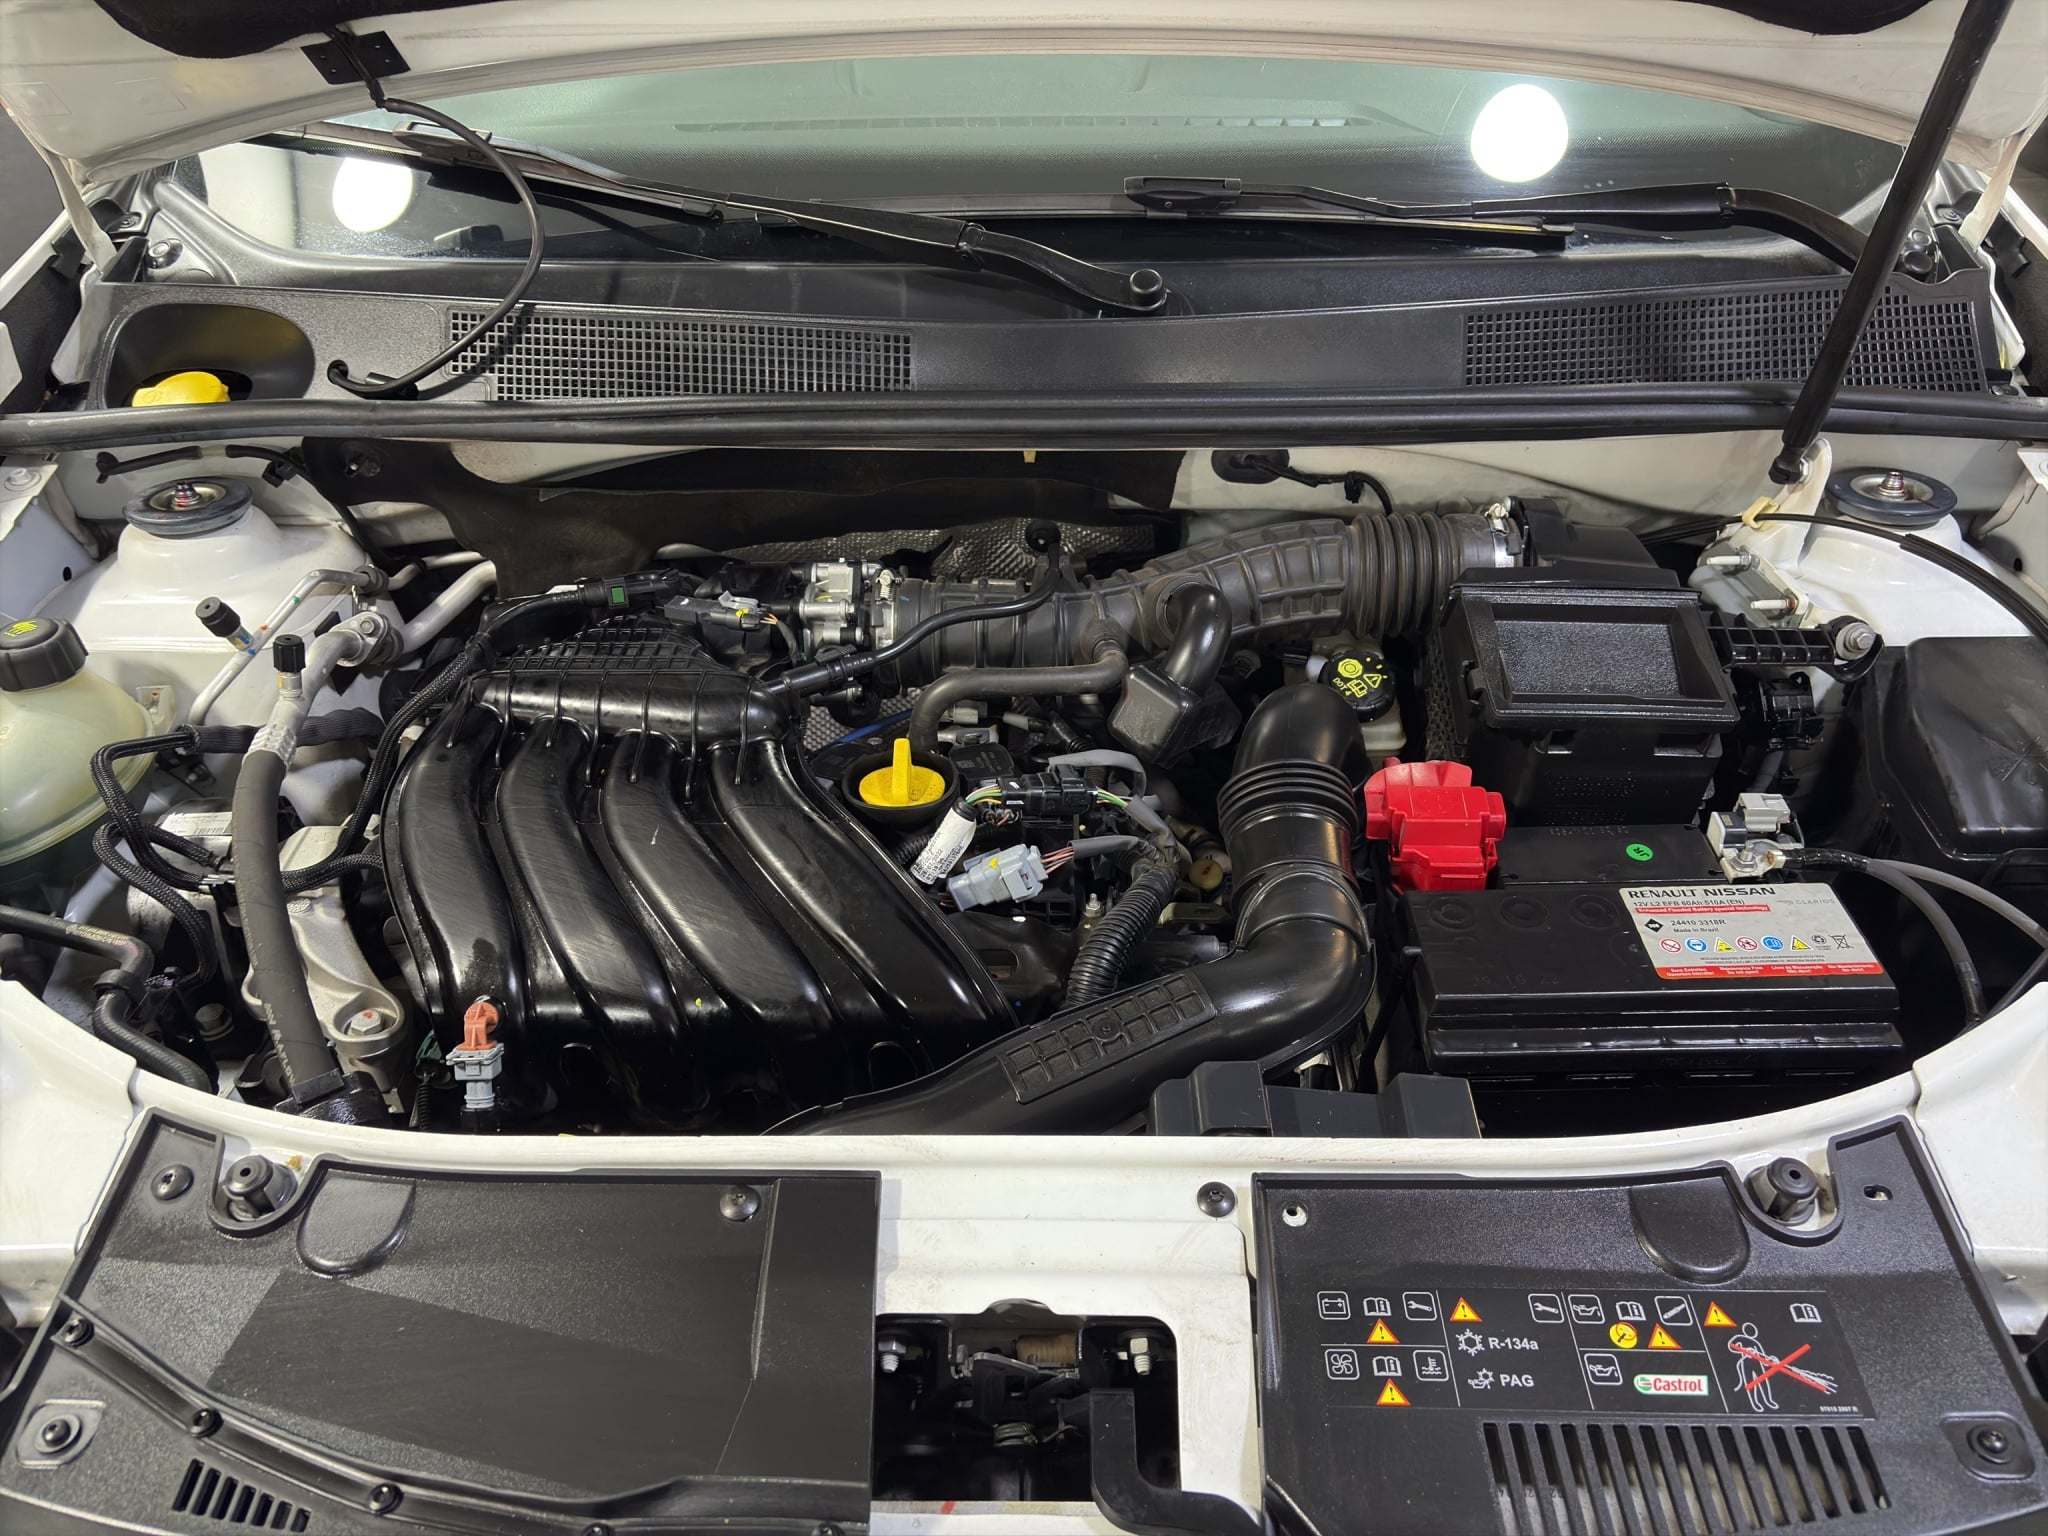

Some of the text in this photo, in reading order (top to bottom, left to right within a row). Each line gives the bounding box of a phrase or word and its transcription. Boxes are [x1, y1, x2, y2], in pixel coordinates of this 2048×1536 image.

[1332, 677, 1348, 690] DOT
[1628, 887, 1776, 899] RENAULT NISSAN
[1488, 1337, 1539, 1350] R-134a
[1500, 1374, 1535, 1387] PAG
[1653, 1377, 1704, 1392] Castrol
